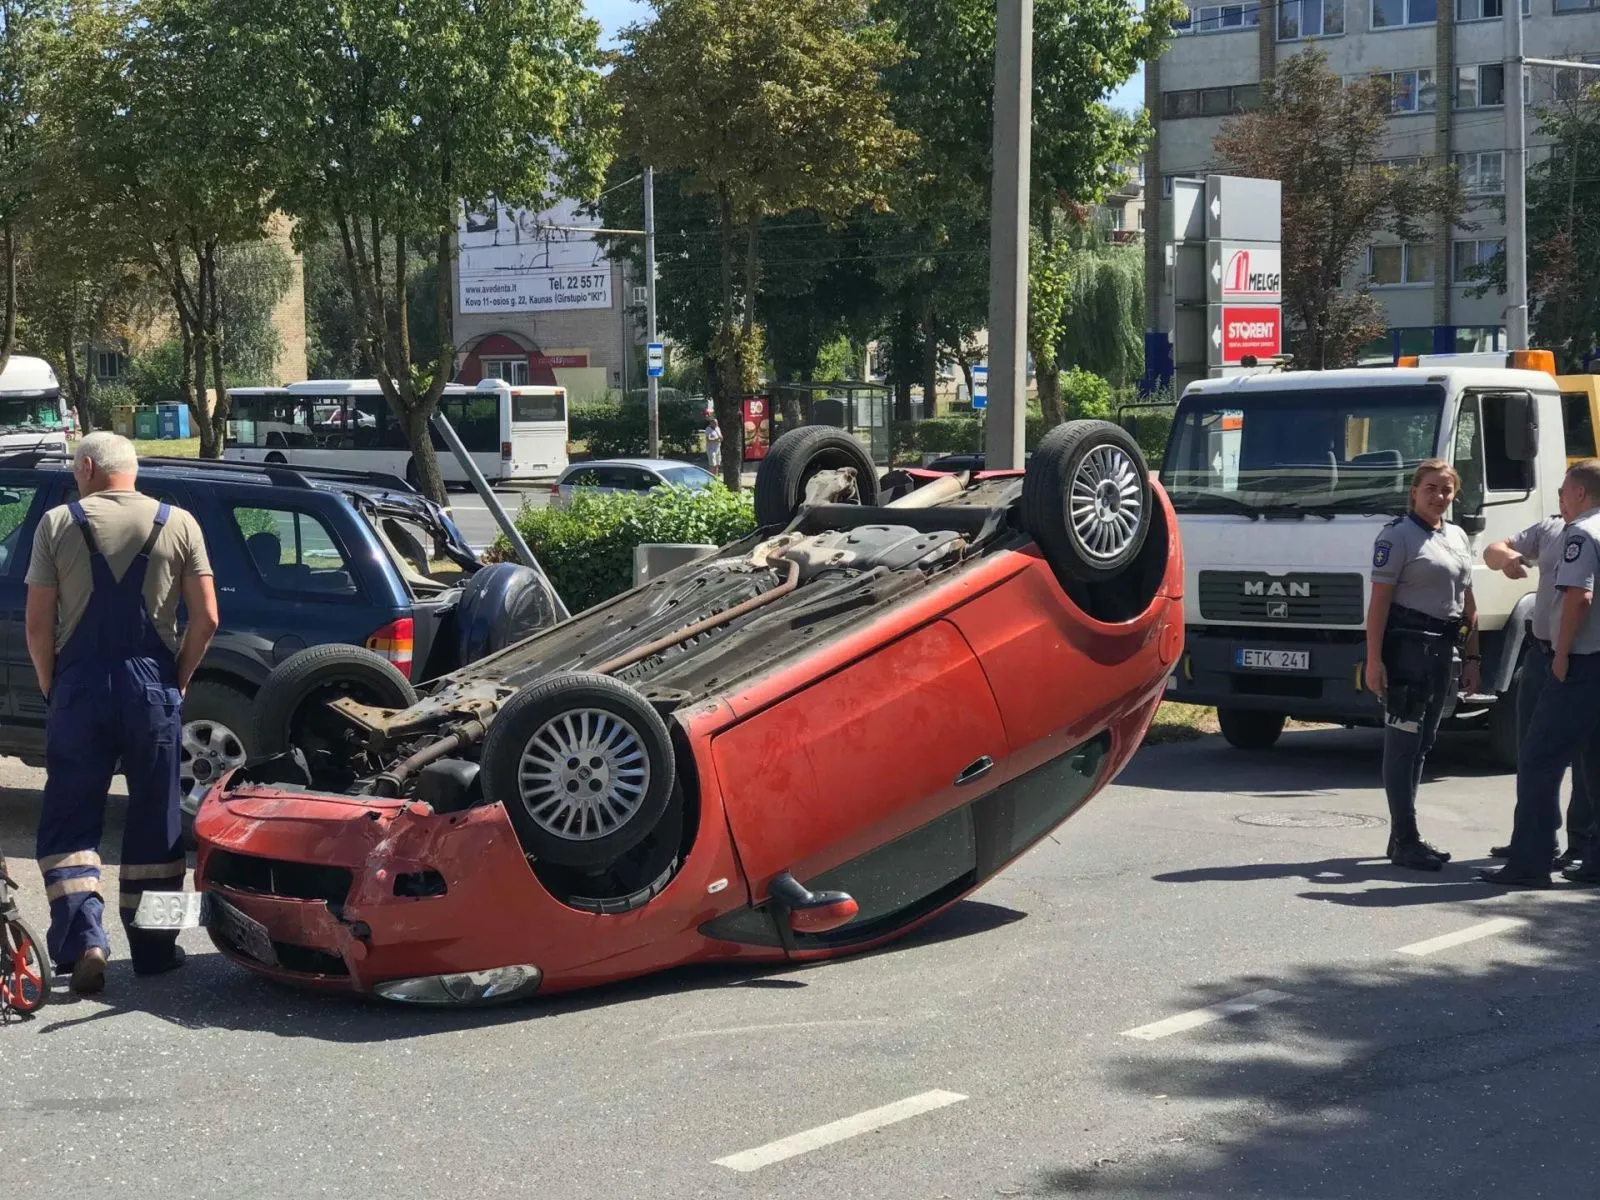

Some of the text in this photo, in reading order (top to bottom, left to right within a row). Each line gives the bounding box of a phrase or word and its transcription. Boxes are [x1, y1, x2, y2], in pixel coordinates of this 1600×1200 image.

[465, 284, 517, 293] www.avedenta.lt
[548, 275, 605, 290] Tel. 22 55 77
[1249, 273, 1280, 292] MELGA
[465, 297, 481, 306] Kovo
[482, 297, 509, 306] 11-osios
[510, 298, 517, 307] g.
[518, 296, 528, 306] 22,
[529, 295, 552, 304] Kaunas
[554, 292, 587, 304] (Girstupio
[1228, 322, 1274, 340] STORENT
[1244, 581, 1310, 597] MAN
[1244, 651, 1306, 668] ETK 241
